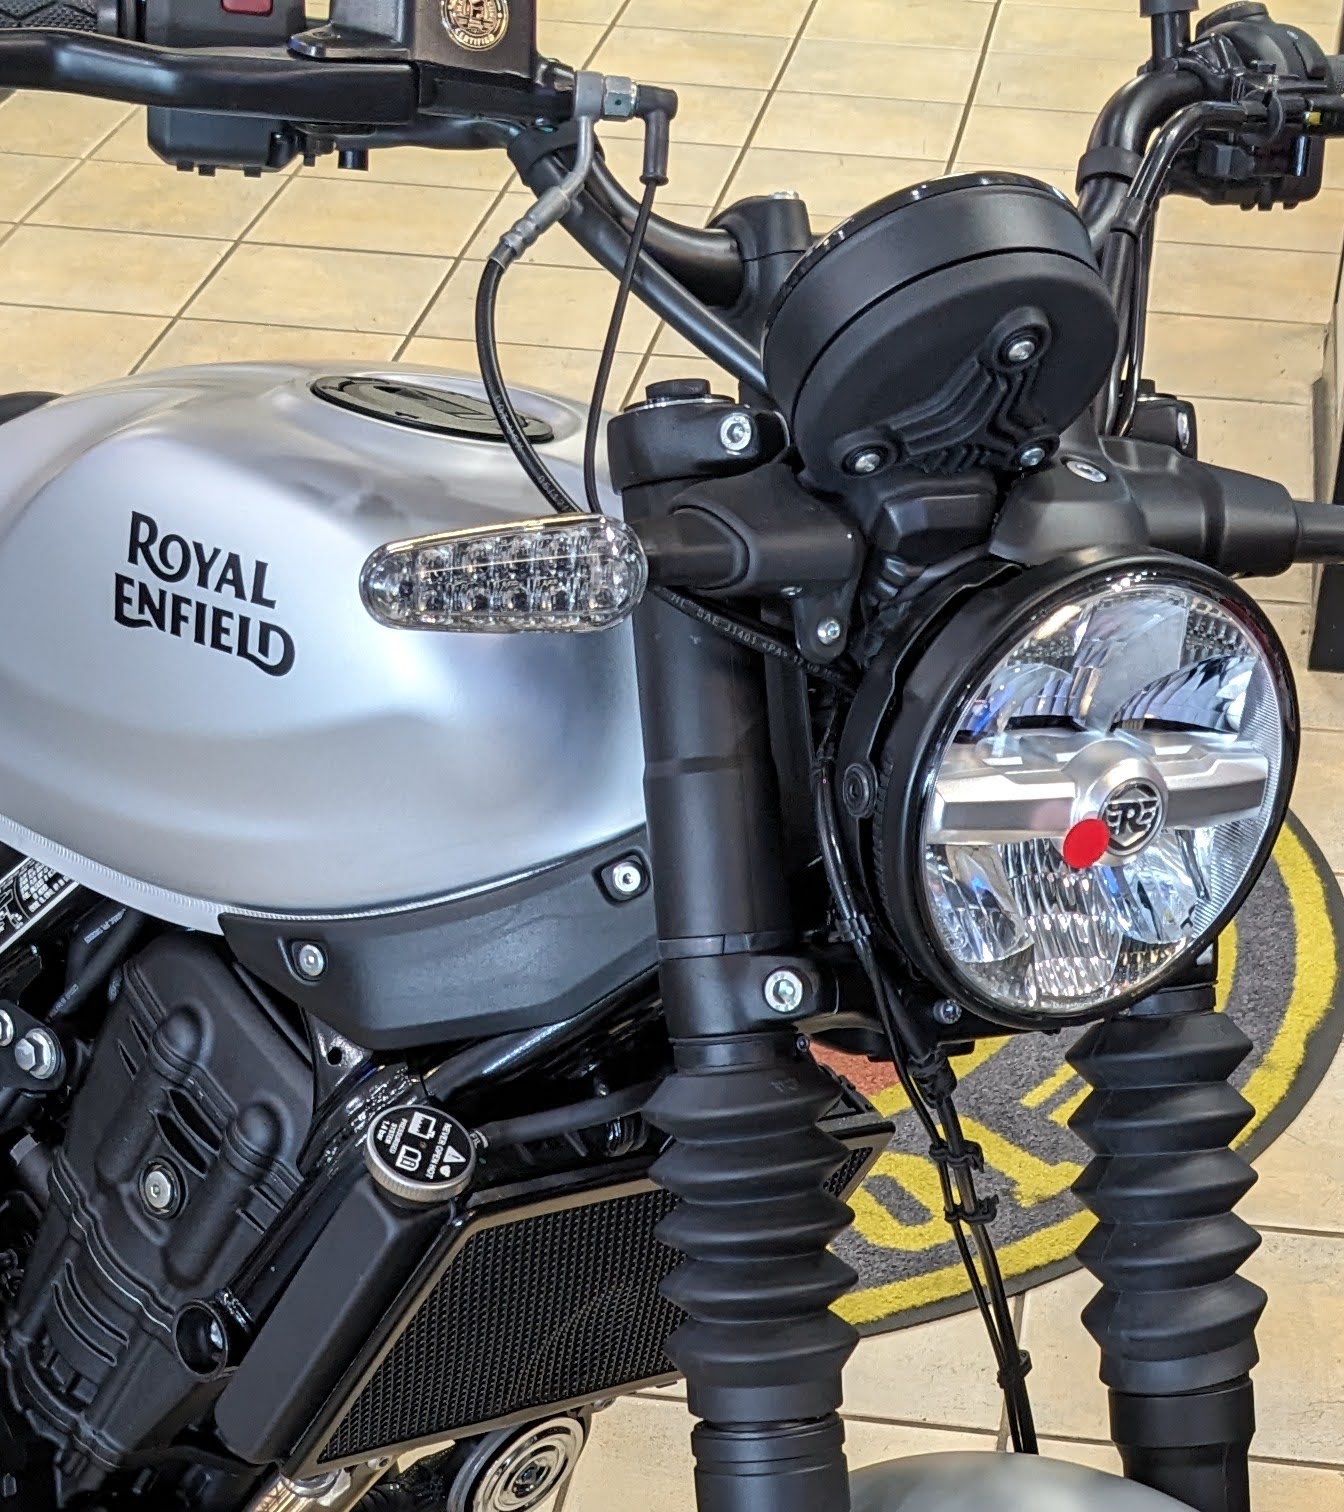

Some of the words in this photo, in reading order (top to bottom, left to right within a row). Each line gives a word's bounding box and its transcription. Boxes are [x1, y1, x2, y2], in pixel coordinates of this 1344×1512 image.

[128, 510, 276, 609] ROYAL
[114, 572, 296, 677] ENFIELD
[696, 608, 720, 627] SAE
[437, 1122, 453, 1146] NEVER
[431, 1145, 444, 1164] OPEN
[425, 1164, 437, 1180] HOT
